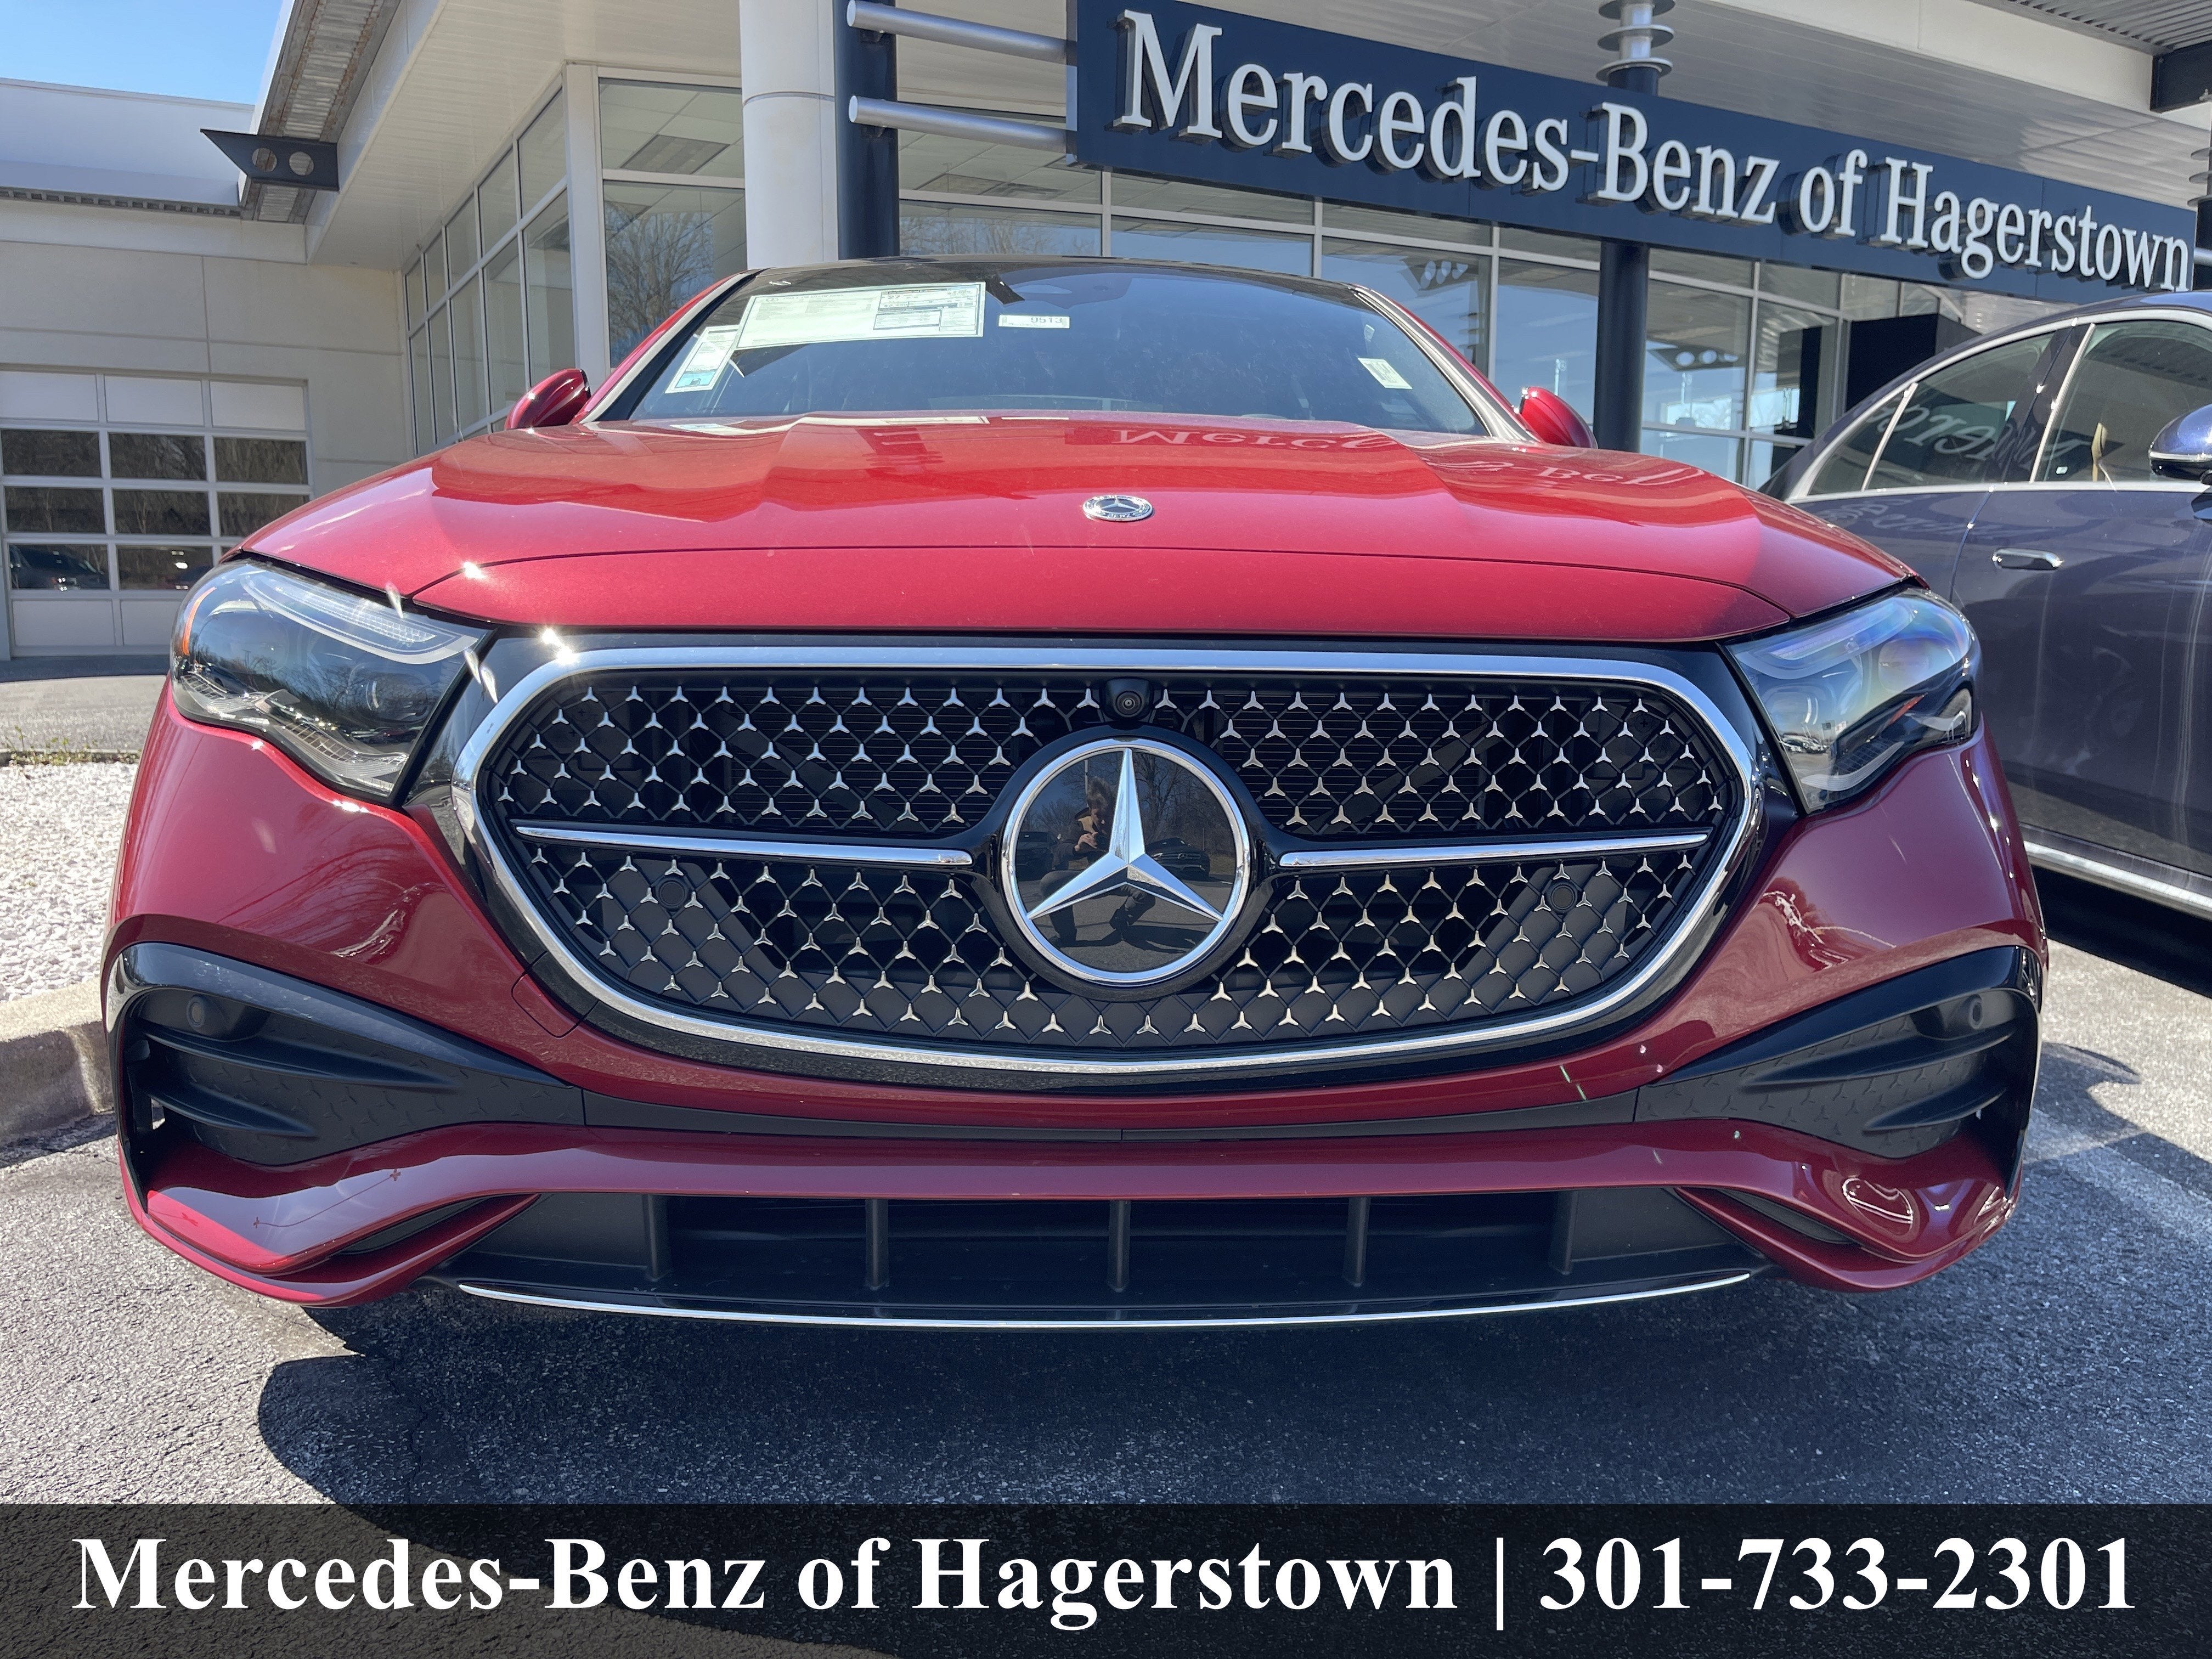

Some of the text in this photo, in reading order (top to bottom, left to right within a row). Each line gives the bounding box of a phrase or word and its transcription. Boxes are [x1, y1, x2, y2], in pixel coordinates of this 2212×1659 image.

[1113, 9, 2190, 292] Mercedes-Benz of Hagerstown
